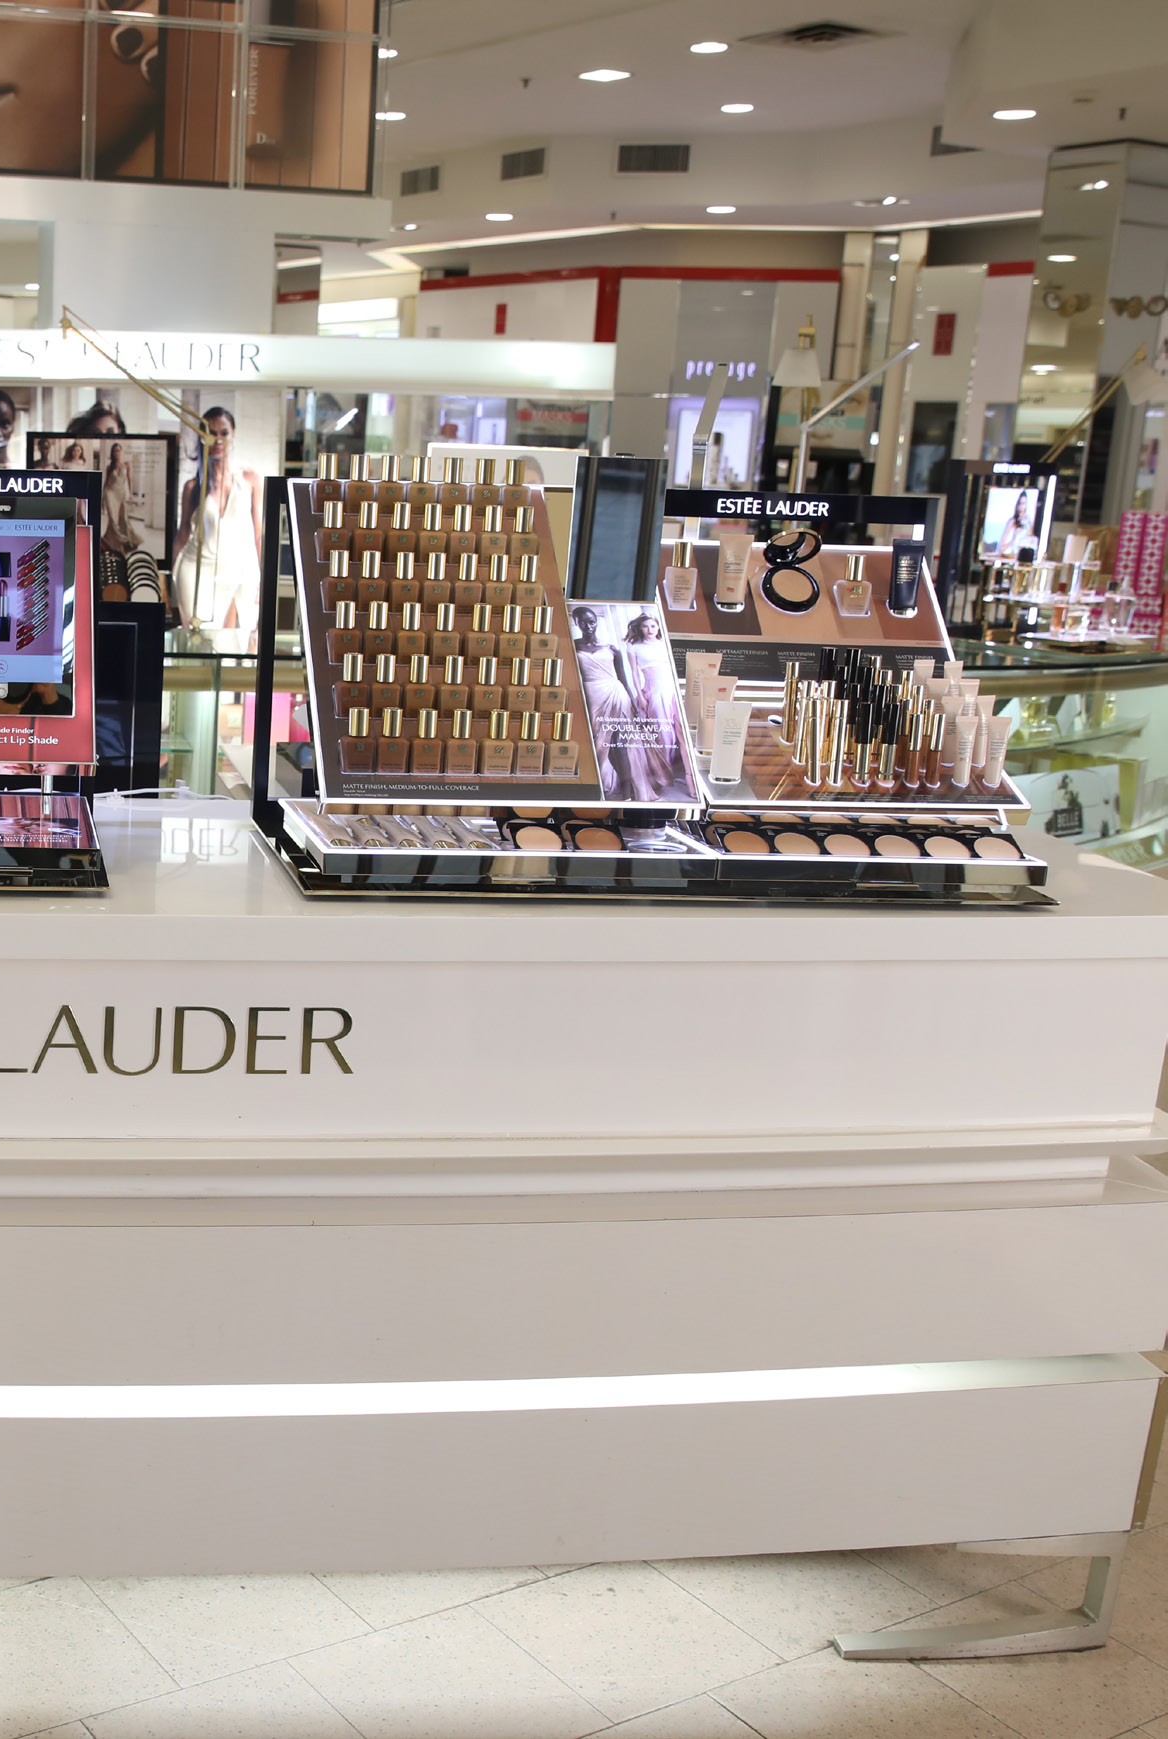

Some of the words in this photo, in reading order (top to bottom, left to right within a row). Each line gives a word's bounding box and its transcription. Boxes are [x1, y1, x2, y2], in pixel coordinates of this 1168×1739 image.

[765, 499, 830, 517] LAUDER
[11, 727, 35, 735] Finder
[601, 724, 642, 732] DOUBLE
[642, 724, 673, 733] WEAR
[10, 735, 26, 746] Lip
[27, 735, 59, 745] Shade
[618, 732, 659, 741] MAKEUP
